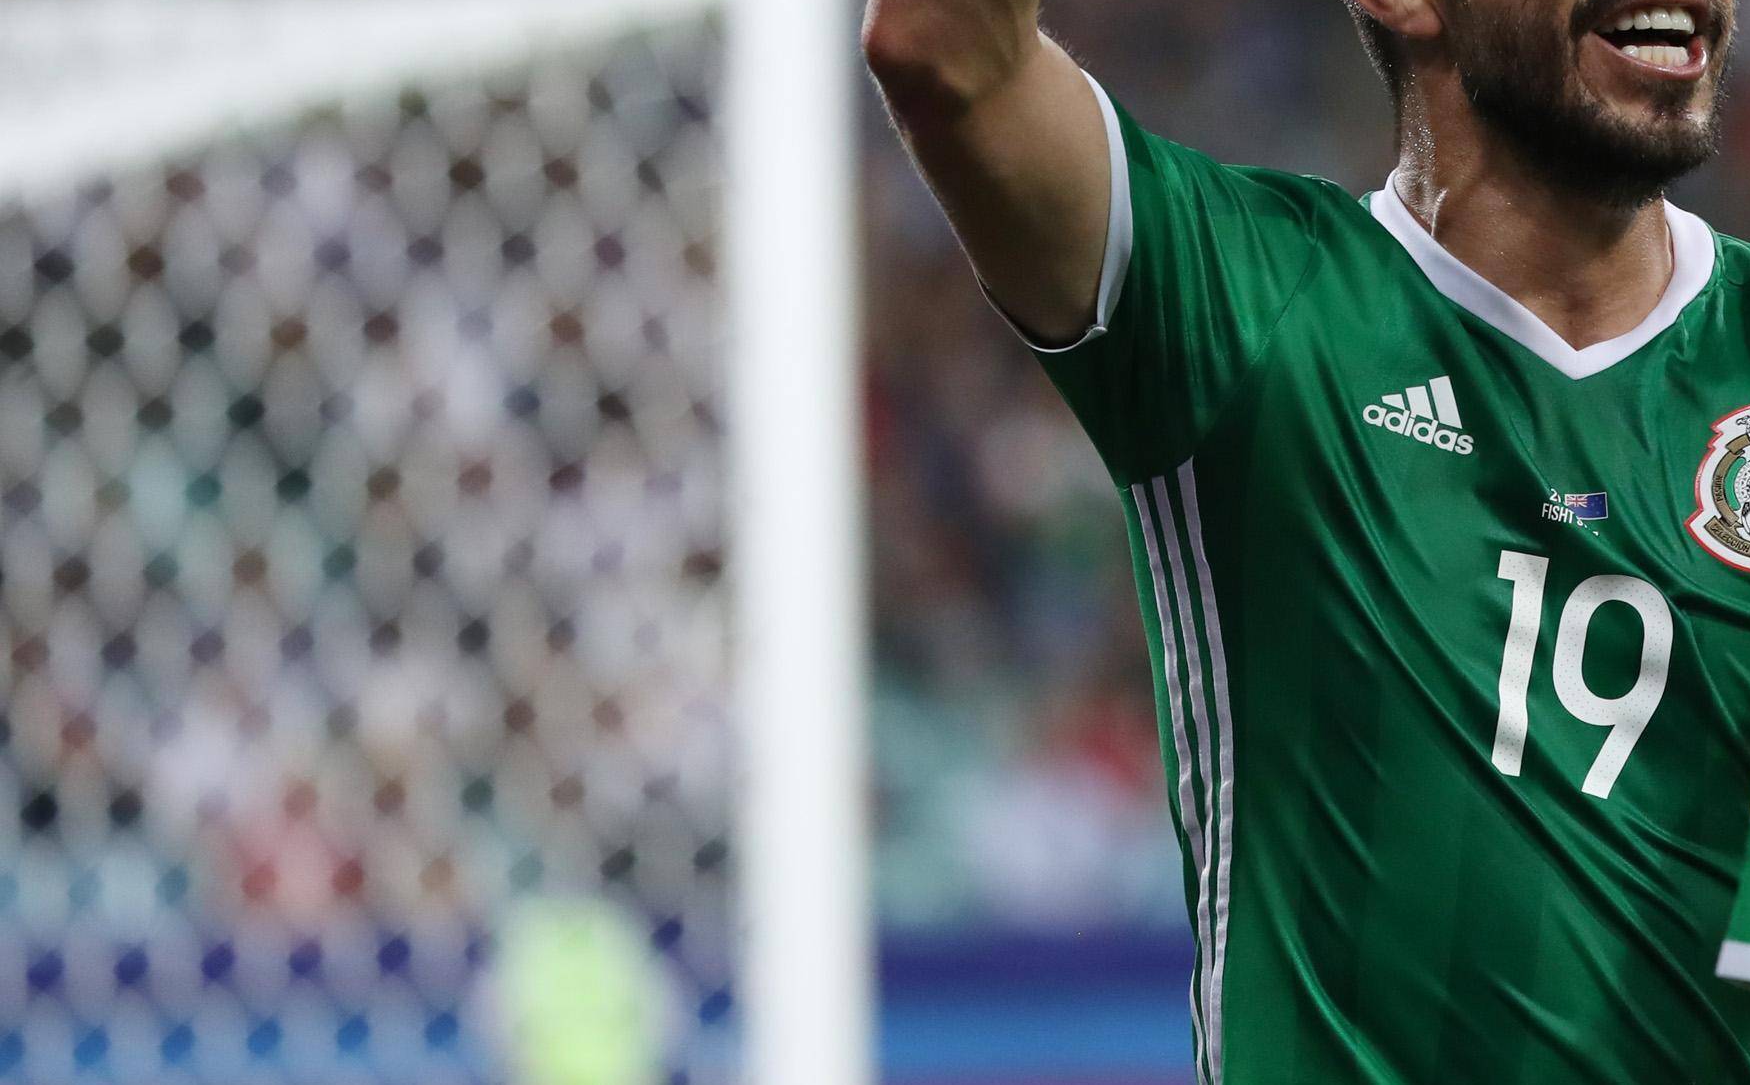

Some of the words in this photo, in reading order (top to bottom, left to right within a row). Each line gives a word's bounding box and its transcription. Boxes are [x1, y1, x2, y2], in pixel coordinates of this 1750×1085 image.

[1362, 404, 1475, 455] adidas
[1541, 503, 1575, 524] FISHT
[1491, 549, 1674, 799] 19
